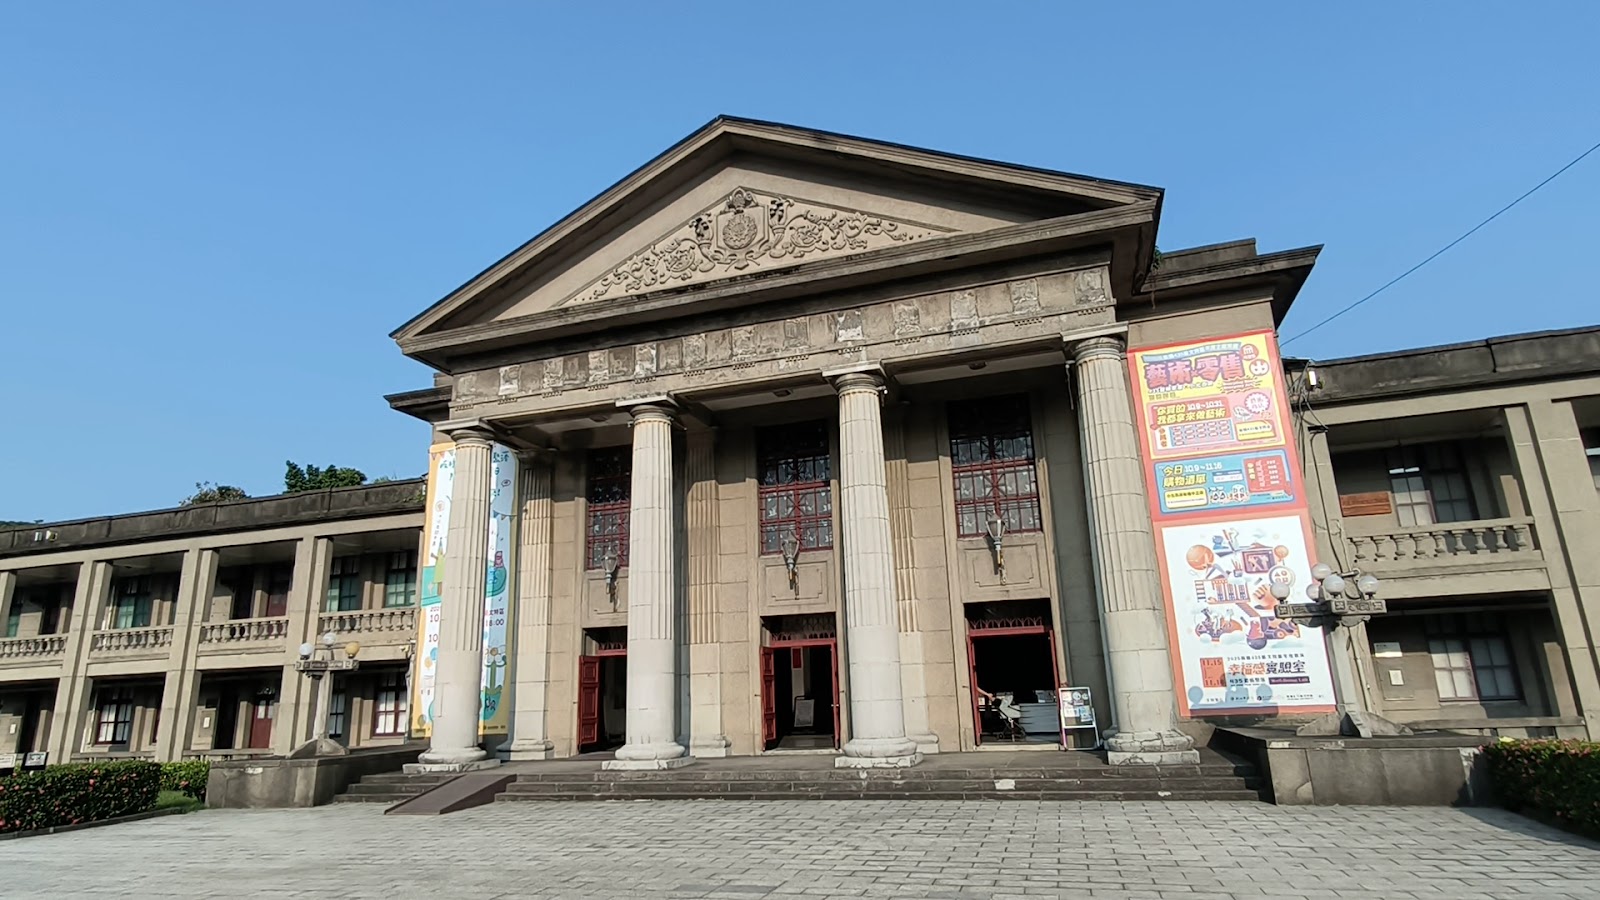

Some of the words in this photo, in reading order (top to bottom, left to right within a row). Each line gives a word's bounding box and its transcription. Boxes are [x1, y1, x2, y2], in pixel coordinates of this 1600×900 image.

[1164, 464, 1183, 476] 今日
[1163, 474, 1206, 488] 購物清單
[430, 614, 439, 622] 10
[428, 634, 438, 642] 10
[1228, 660, 1306, 676] 幸福感實驗室
